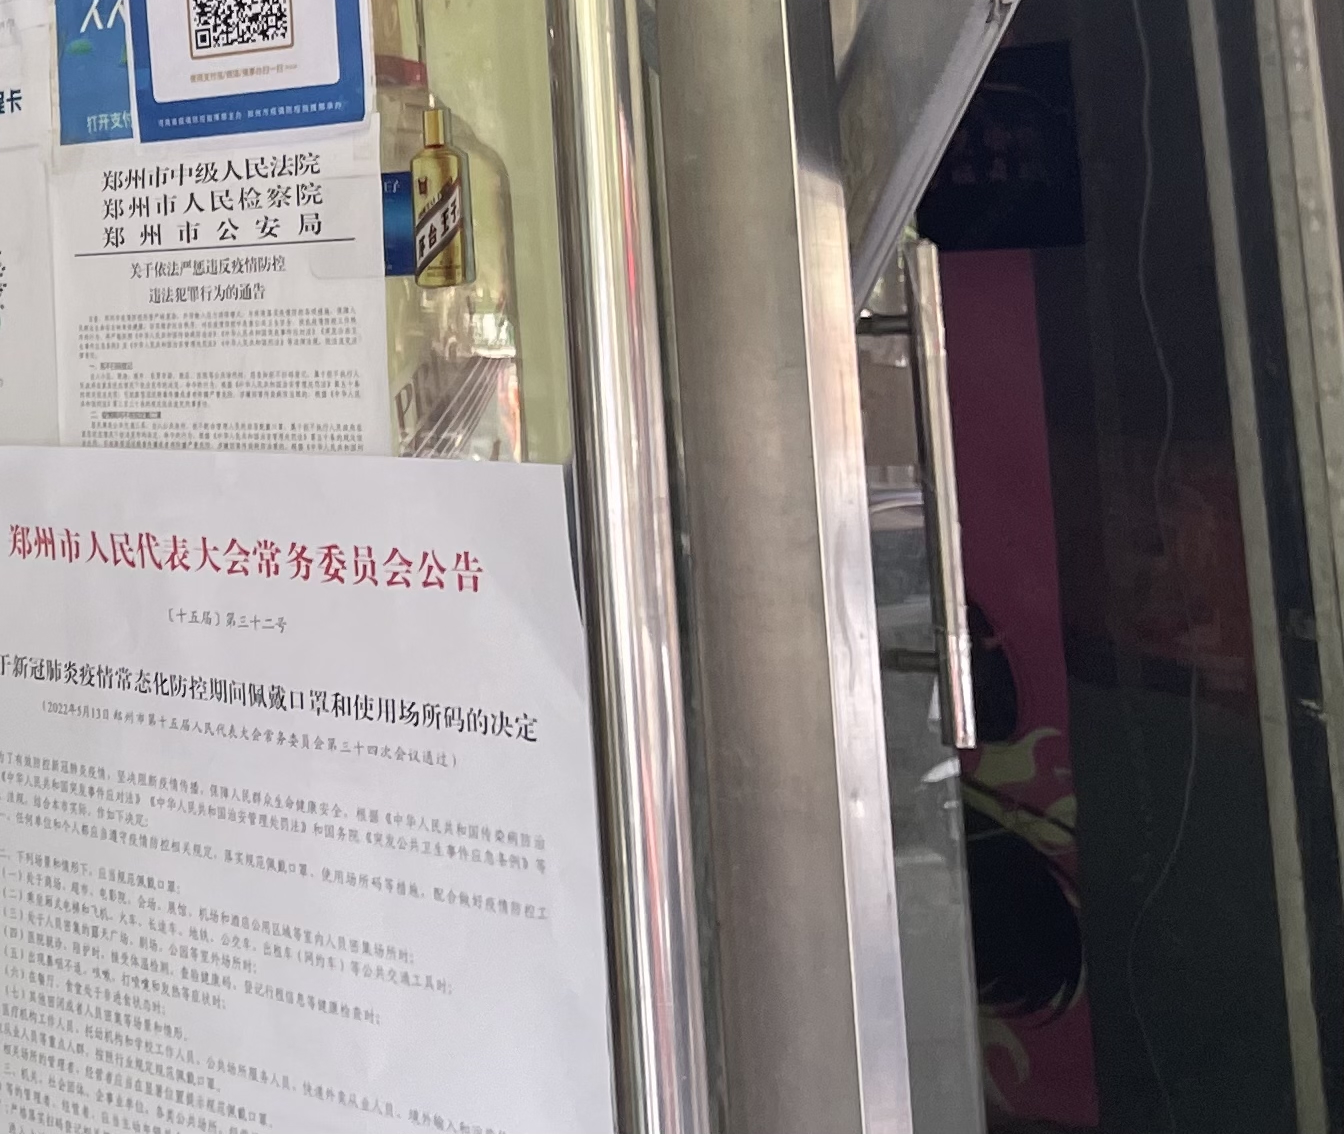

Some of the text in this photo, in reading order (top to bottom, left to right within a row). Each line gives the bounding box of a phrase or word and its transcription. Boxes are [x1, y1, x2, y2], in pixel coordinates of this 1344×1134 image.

[102, 152, 321, 192] 郑州市中级人民法院
[102, 182, 324, 220] 郑州市人民检察院
[103, 213, 323, 248] 郑州市公安局
[130, 254, 286, 279] 关于依法严惩违反疫情防控
[149, 283, 265, 304] 违法犯罪行为的通告
[9, 524, 484, 593] 郑州市人民代表大会常务委员会公告
